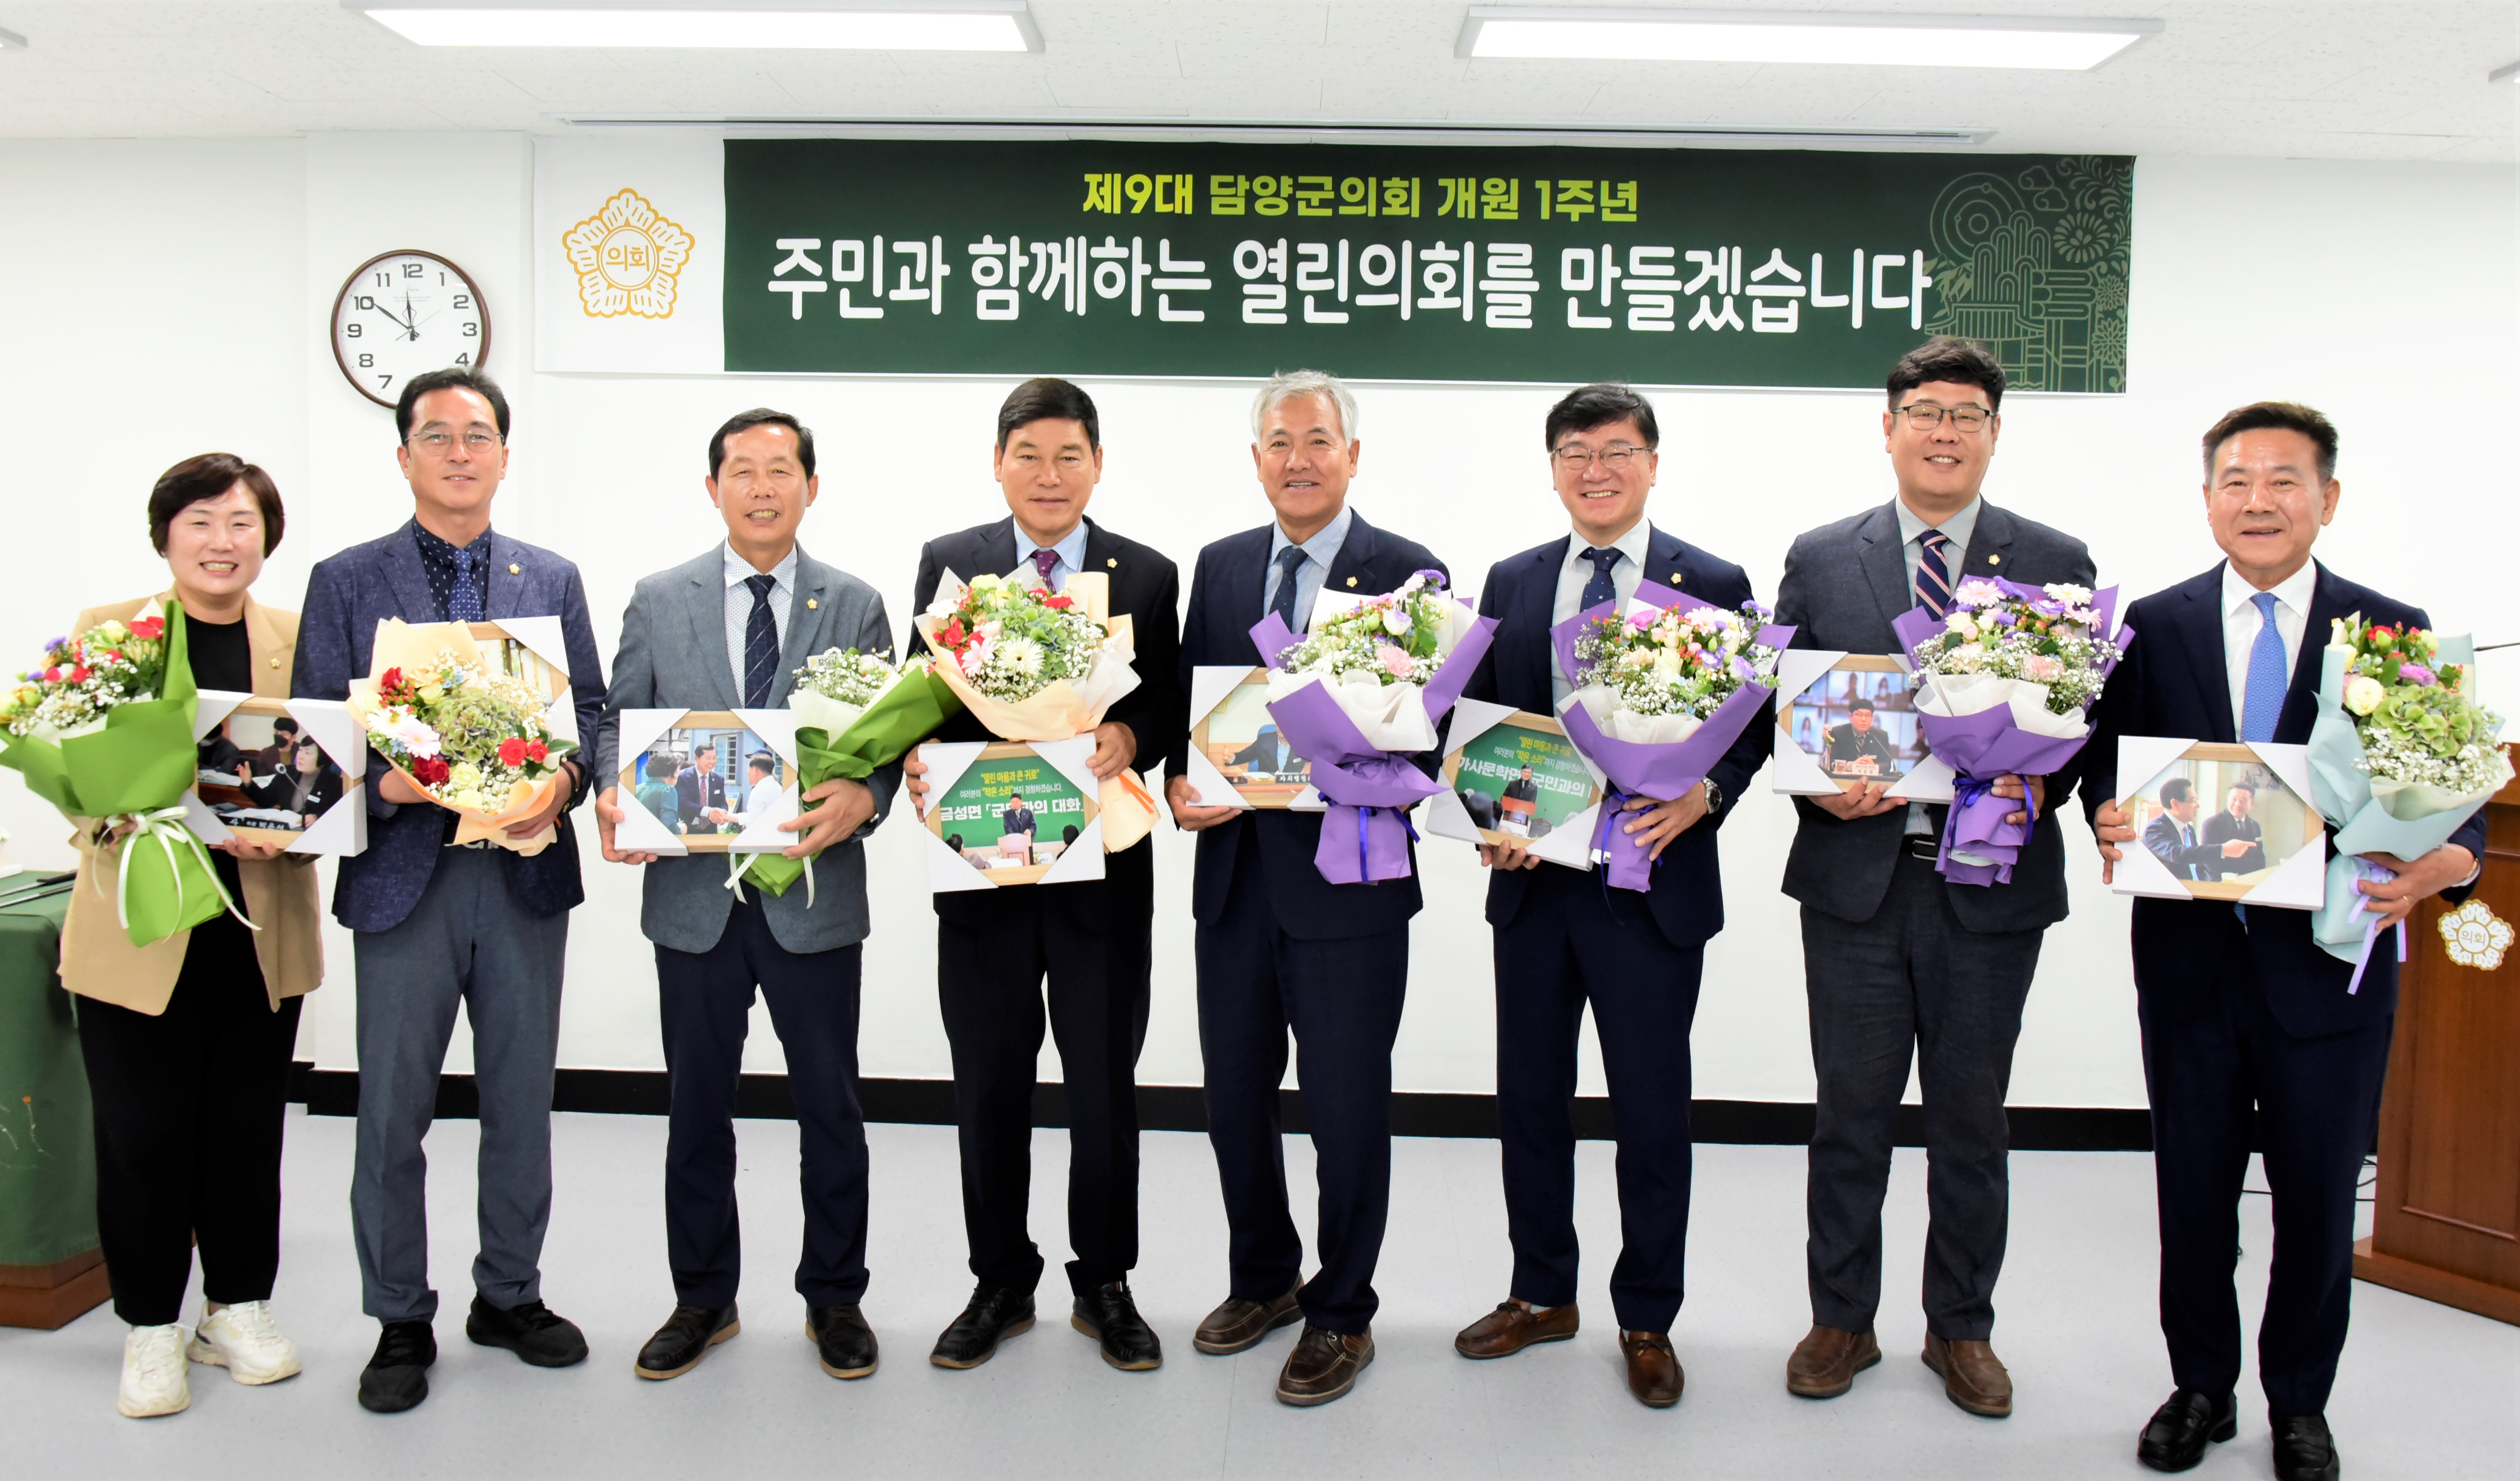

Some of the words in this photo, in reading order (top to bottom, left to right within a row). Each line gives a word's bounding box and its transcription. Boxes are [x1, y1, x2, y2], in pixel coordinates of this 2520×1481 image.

[1084, 174, 1192, 214] 제9대
[1211, 176, 1419, 217] 담양군의회
[1438, 179, 1518, 219] 개원
[1536, 181, 1638, 221] 1주년
[606, 244, 650, 271] 의회
[402, 264, 423, 278] 12
[376, 273, 390, 287] 11
[439, 272, 445, 286] 1
[769, 235, 950, 319] 주민과
[968, 235, 1211, 322] 함께하는
[1233, 238, 1539, 328] 열린의회를
[1561, 244, 1932, 332] 만들겠습니다
[354, 296, 374, 310] 10
[453, 295, 469, 309] 2
[348, 324, 362, 337] 9
[462, 322, 477, 336] 3
[359, 354, 374, 367] 8
[455, 352, 470, 367] 4
[378, 375, 393, 389] 7
[1494, 746, 1515, 759] 여러분의
[1459, 757, 1521, 781] 가사문학면
[960, 789, 981, 799] 여러분의
[940, 805, 982, 821] 금성면
[2461, 931, 2485, 945] 의회
